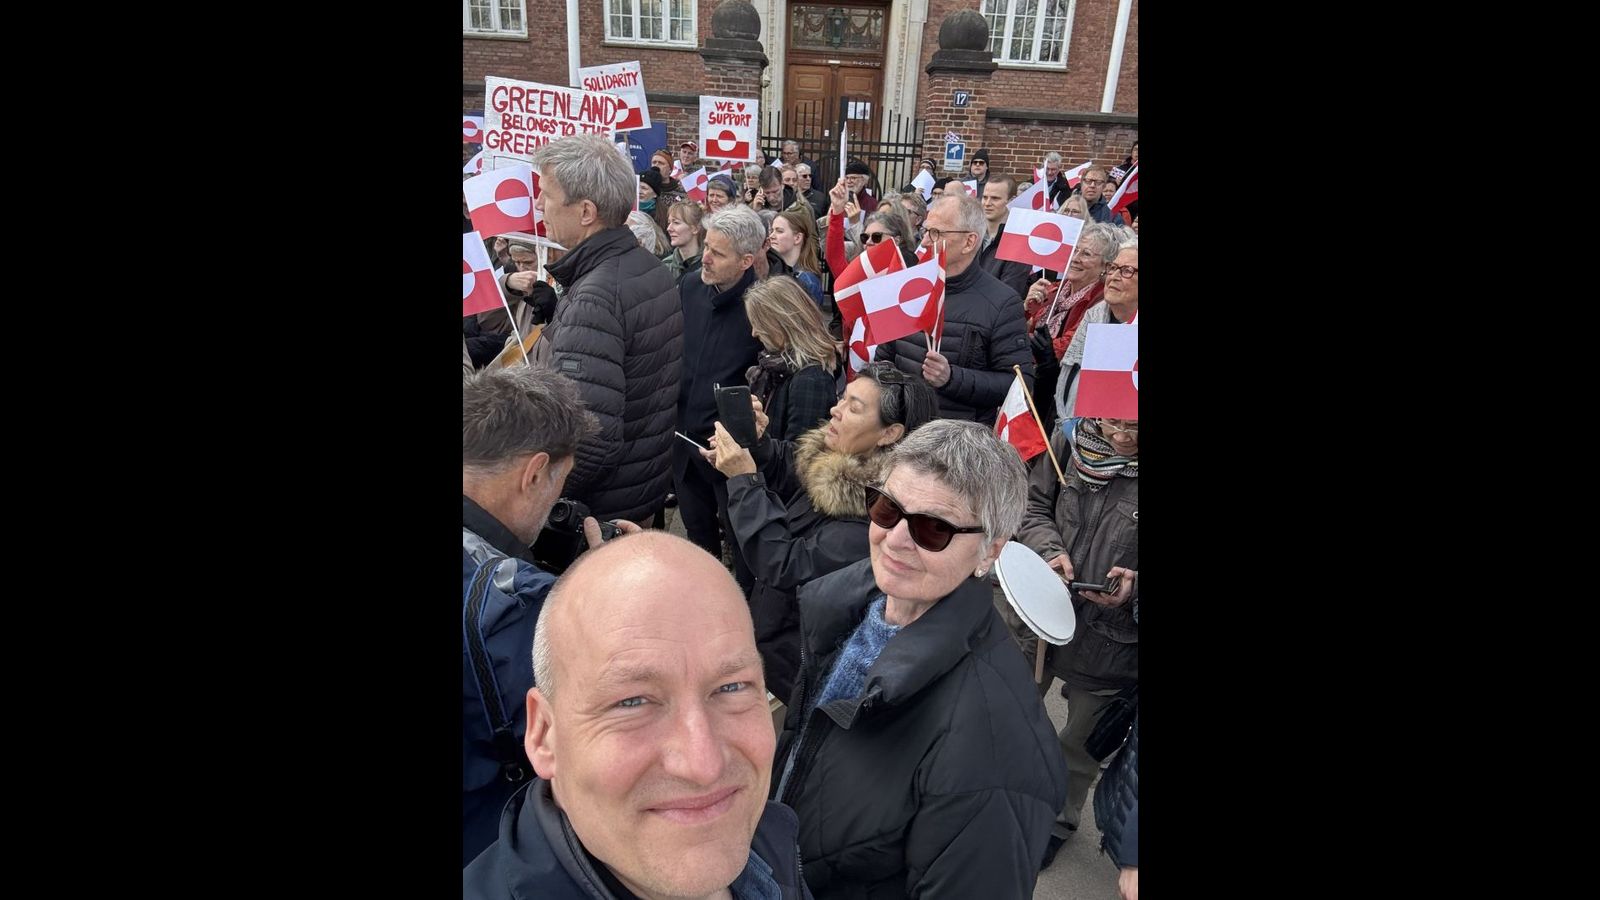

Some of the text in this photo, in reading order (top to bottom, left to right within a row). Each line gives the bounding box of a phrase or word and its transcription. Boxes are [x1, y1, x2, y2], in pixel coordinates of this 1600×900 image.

[492, 85, 617, 126] GREENLAND
[714, 101, 735, 112] WE
[956, 93, 967, 105] 17
[501, 112, 558, 134] BELONGS
[559, 120, 576, 136] TO
[708, 111, 752, 127] SUPPORT
